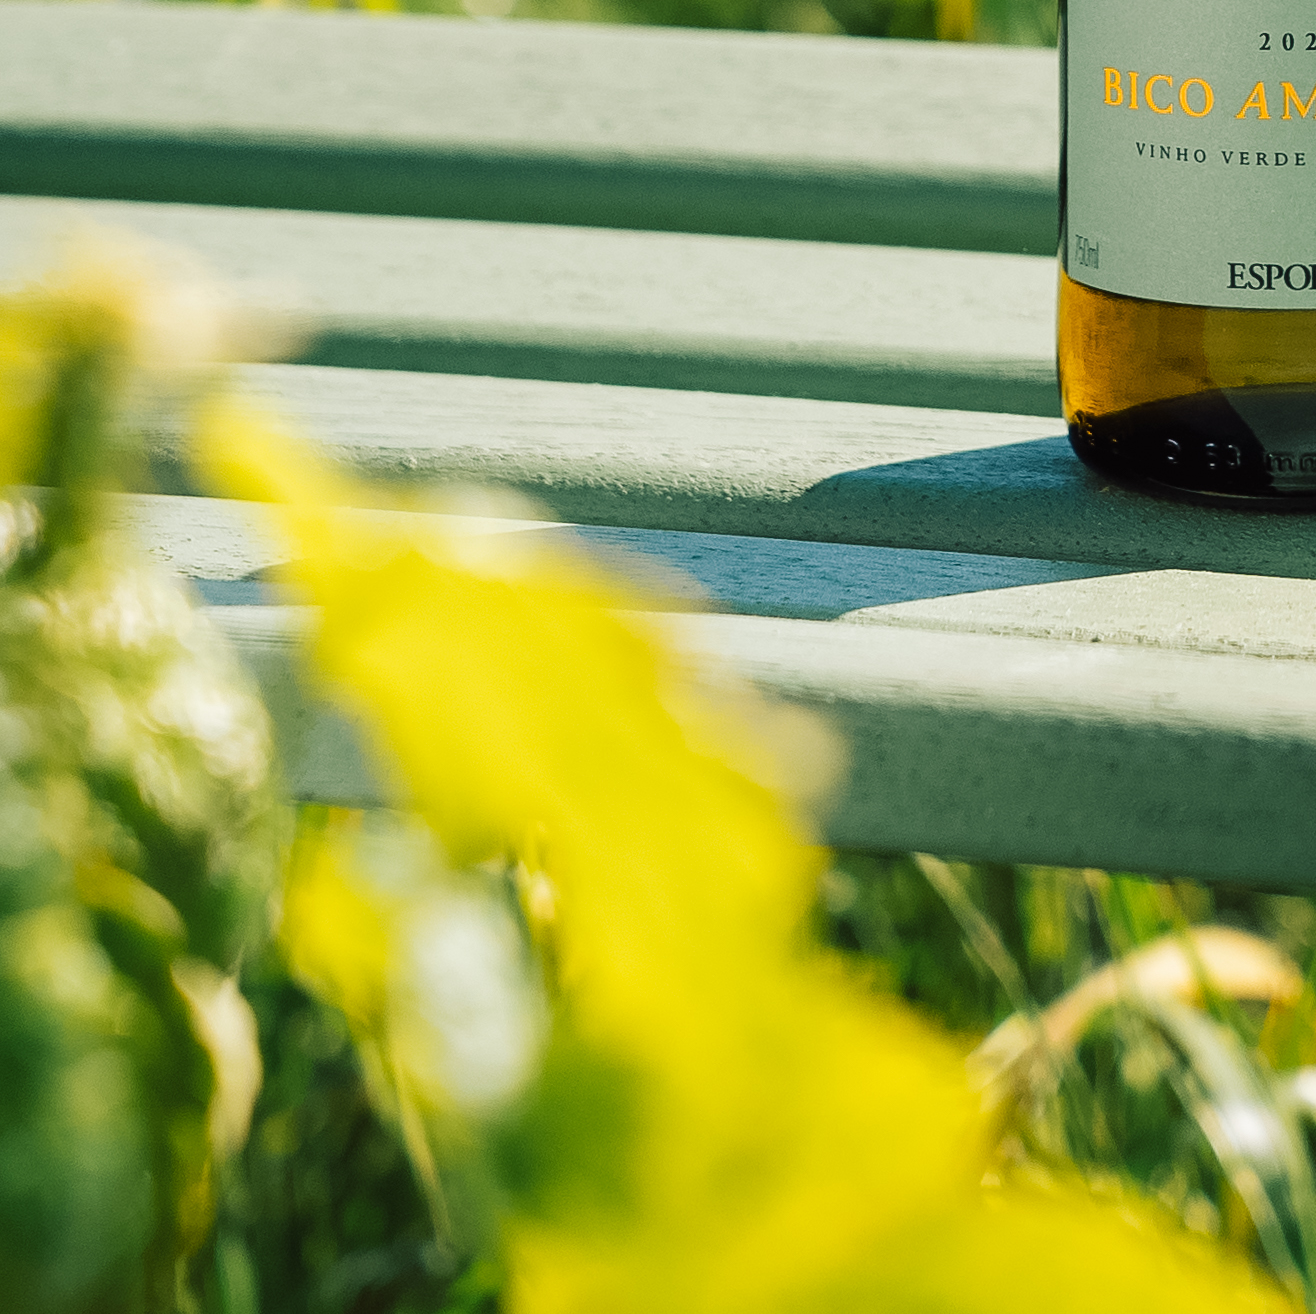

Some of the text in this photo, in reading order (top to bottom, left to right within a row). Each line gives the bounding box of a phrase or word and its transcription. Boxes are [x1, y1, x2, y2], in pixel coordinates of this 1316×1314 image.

[1103, 66, 1215, 119] BICO
[1135, 141, 1207, 164] VINHO
[1221, 150, 1306, 167] VERDE
